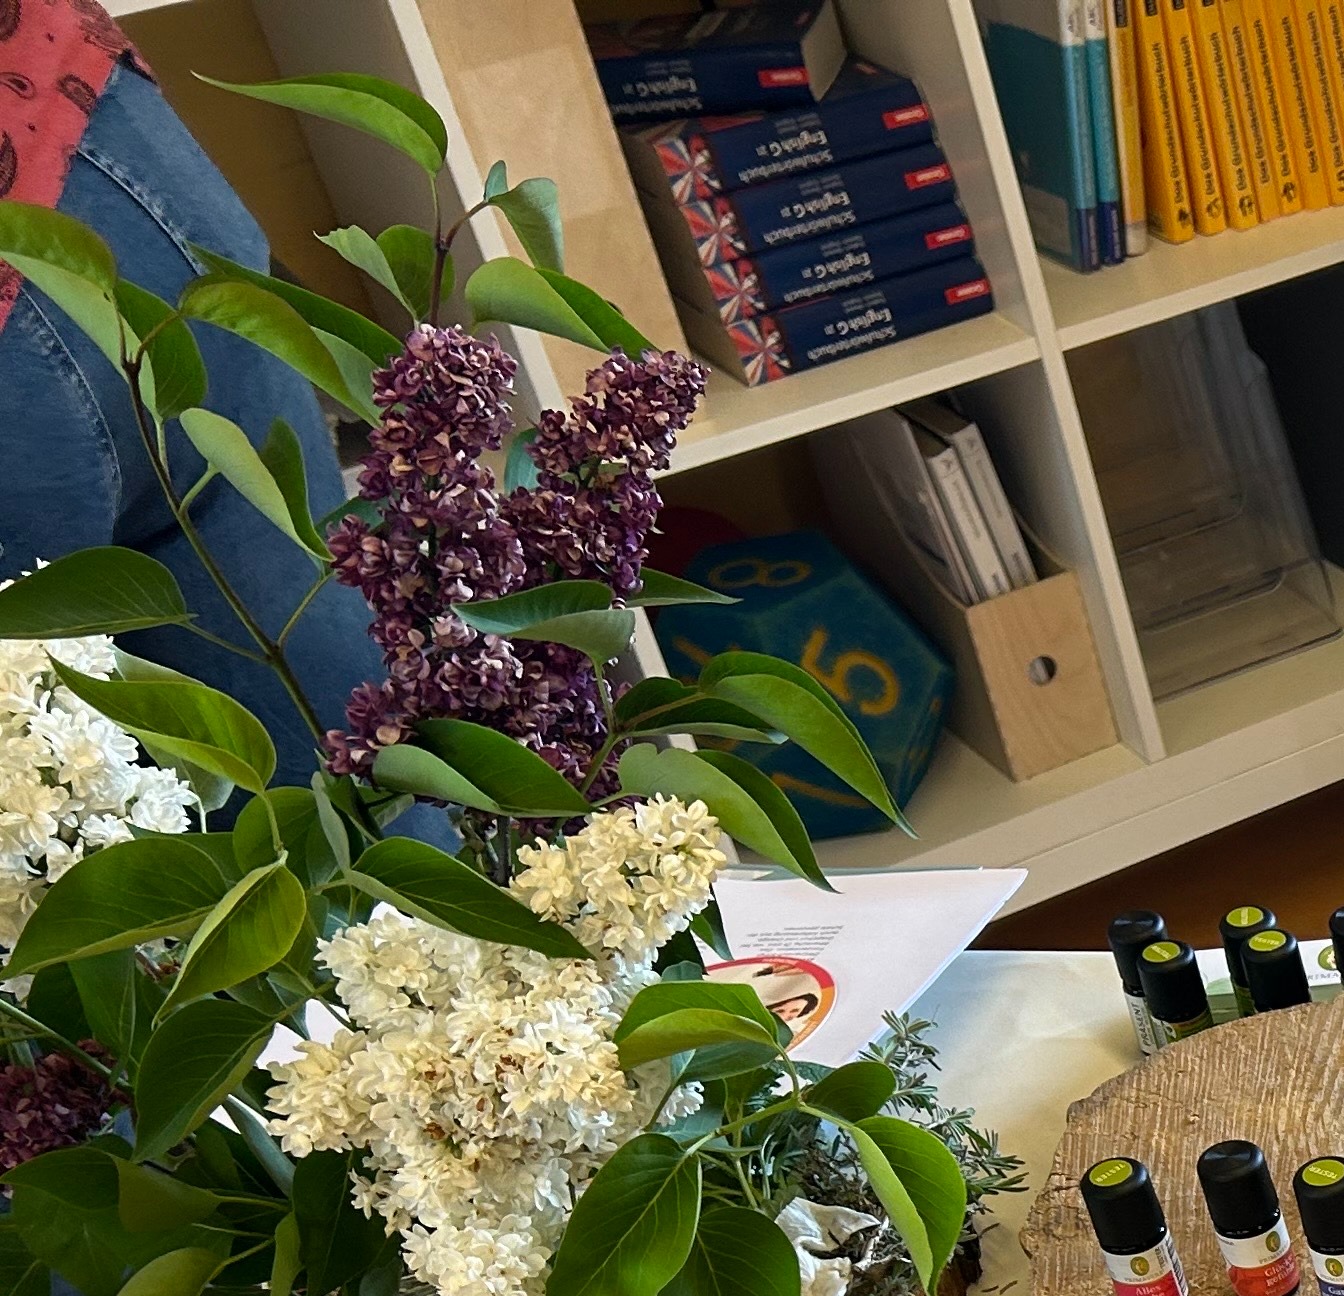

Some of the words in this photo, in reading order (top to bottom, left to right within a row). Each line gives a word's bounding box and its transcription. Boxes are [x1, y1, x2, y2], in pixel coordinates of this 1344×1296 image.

[1095, 1163, 1126, 1183] TESTER
[1308, 1165, 1338, 1179] TESTER
[1135, 1285, 1162, 1295] Alles
